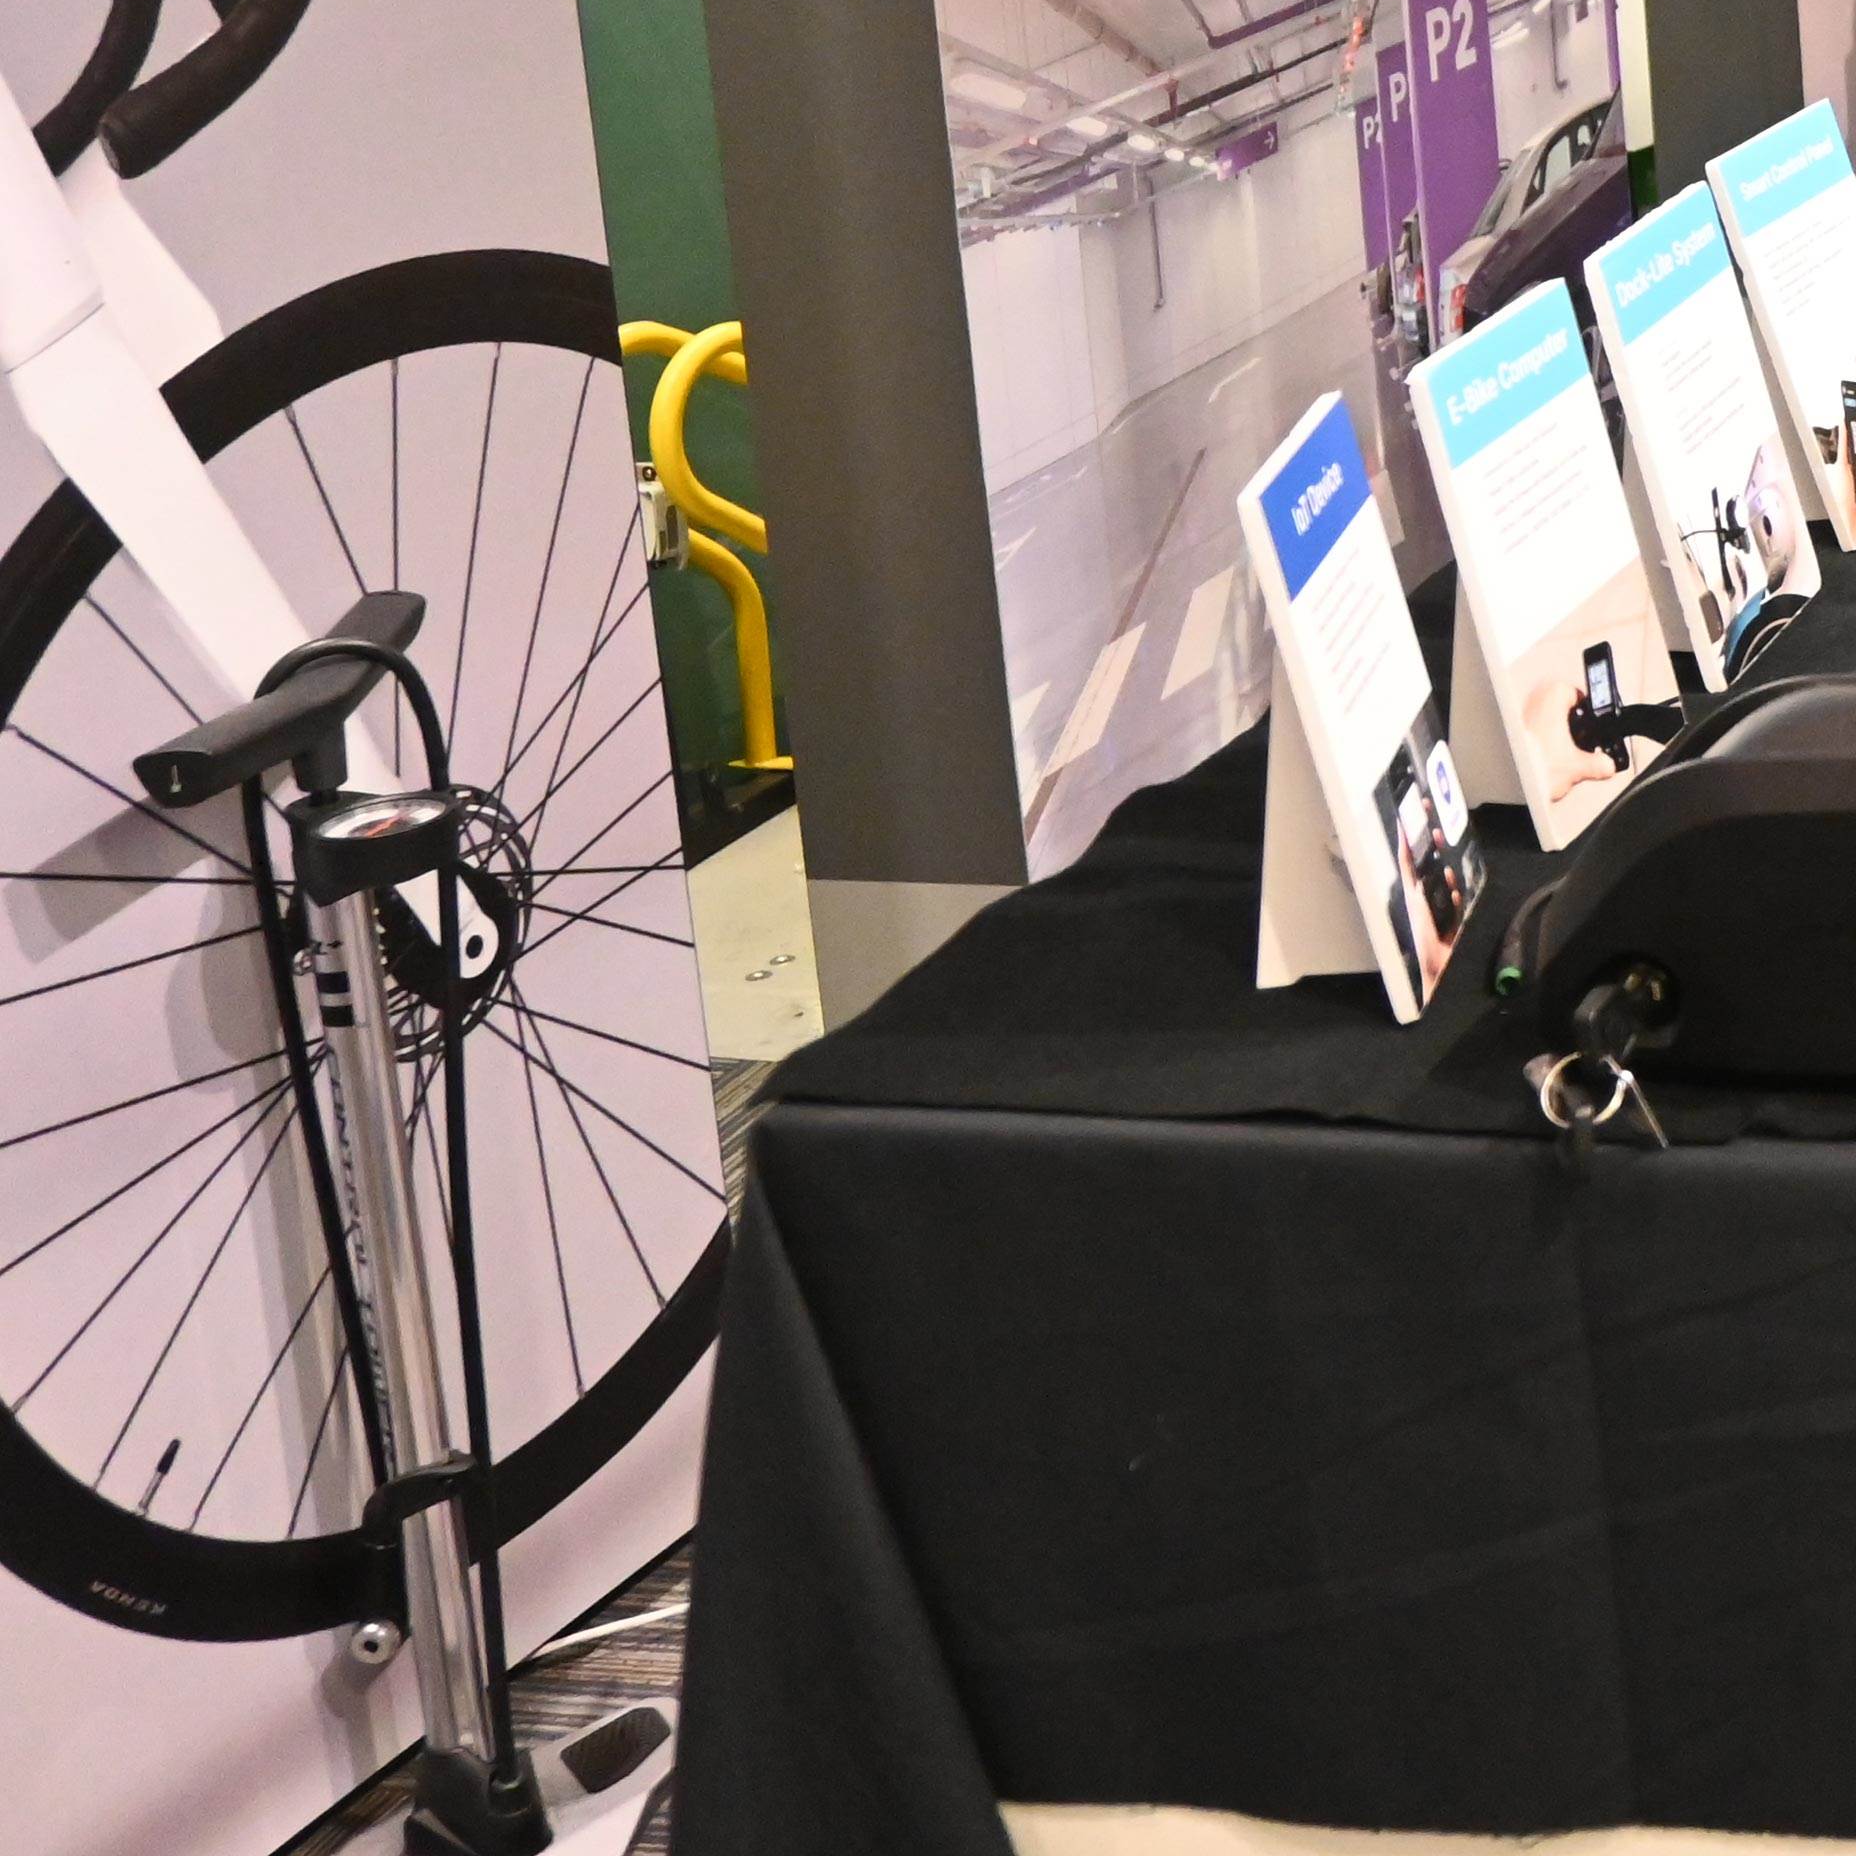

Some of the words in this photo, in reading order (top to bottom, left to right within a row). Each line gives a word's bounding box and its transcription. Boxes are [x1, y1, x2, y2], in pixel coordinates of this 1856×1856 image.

[1671, 221, 1717, 268] System
[1446, 373, 1499, 426] E-Bike
[1497, 328, 1569, 389] Computer
[1290, 494, 1312, 536] IoT
[1306, 461, 1344, 517] Device
[91, 1581, 168, 1615] KENDA
